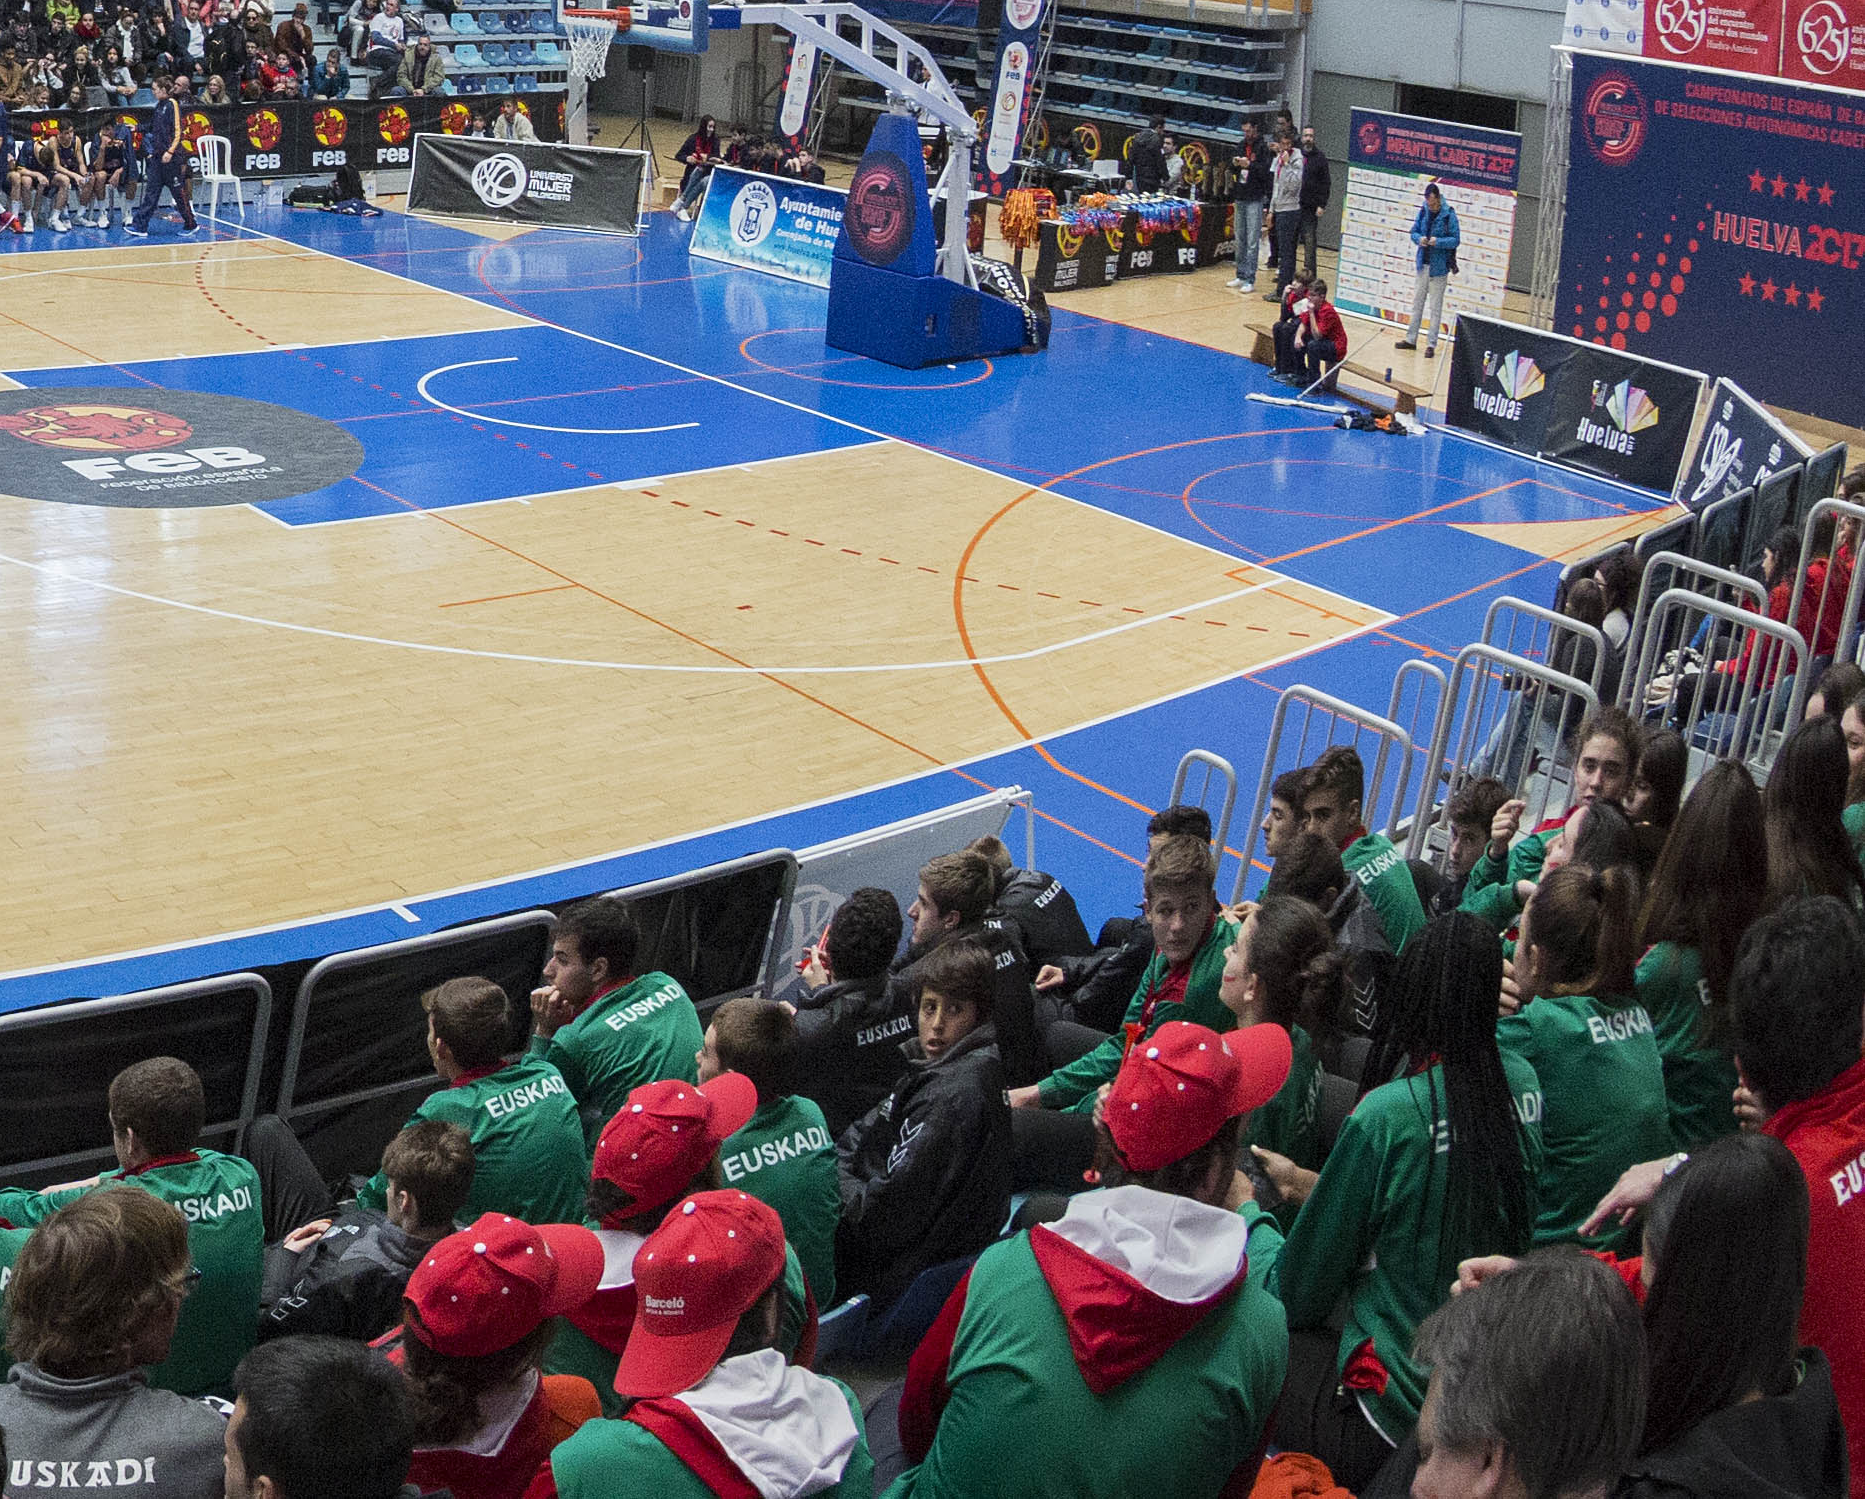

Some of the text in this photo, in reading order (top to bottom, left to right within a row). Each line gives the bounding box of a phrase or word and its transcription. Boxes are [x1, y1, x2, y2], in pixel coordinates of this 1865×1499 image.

[1686, 82, 1768, 110] CAMPEONATOS
[1654, 100, 1669, 115] DE
[1671, 102, 1743, 129] SELECCIONES
[1439, 146, 1485, 170] CADETE
[528, 181, 572, 194] MUJER
[529, 170, 574, 183] UNIVERSO
[795, 215, 814, 231] de
[1713, 211, 1803, 258] HUELVA
[857, 1015, 912, 1047] EUSKADI
[721, 1123, 831, 1184] EUSKADI
[646, 1295, 684, 1308] Barceló
